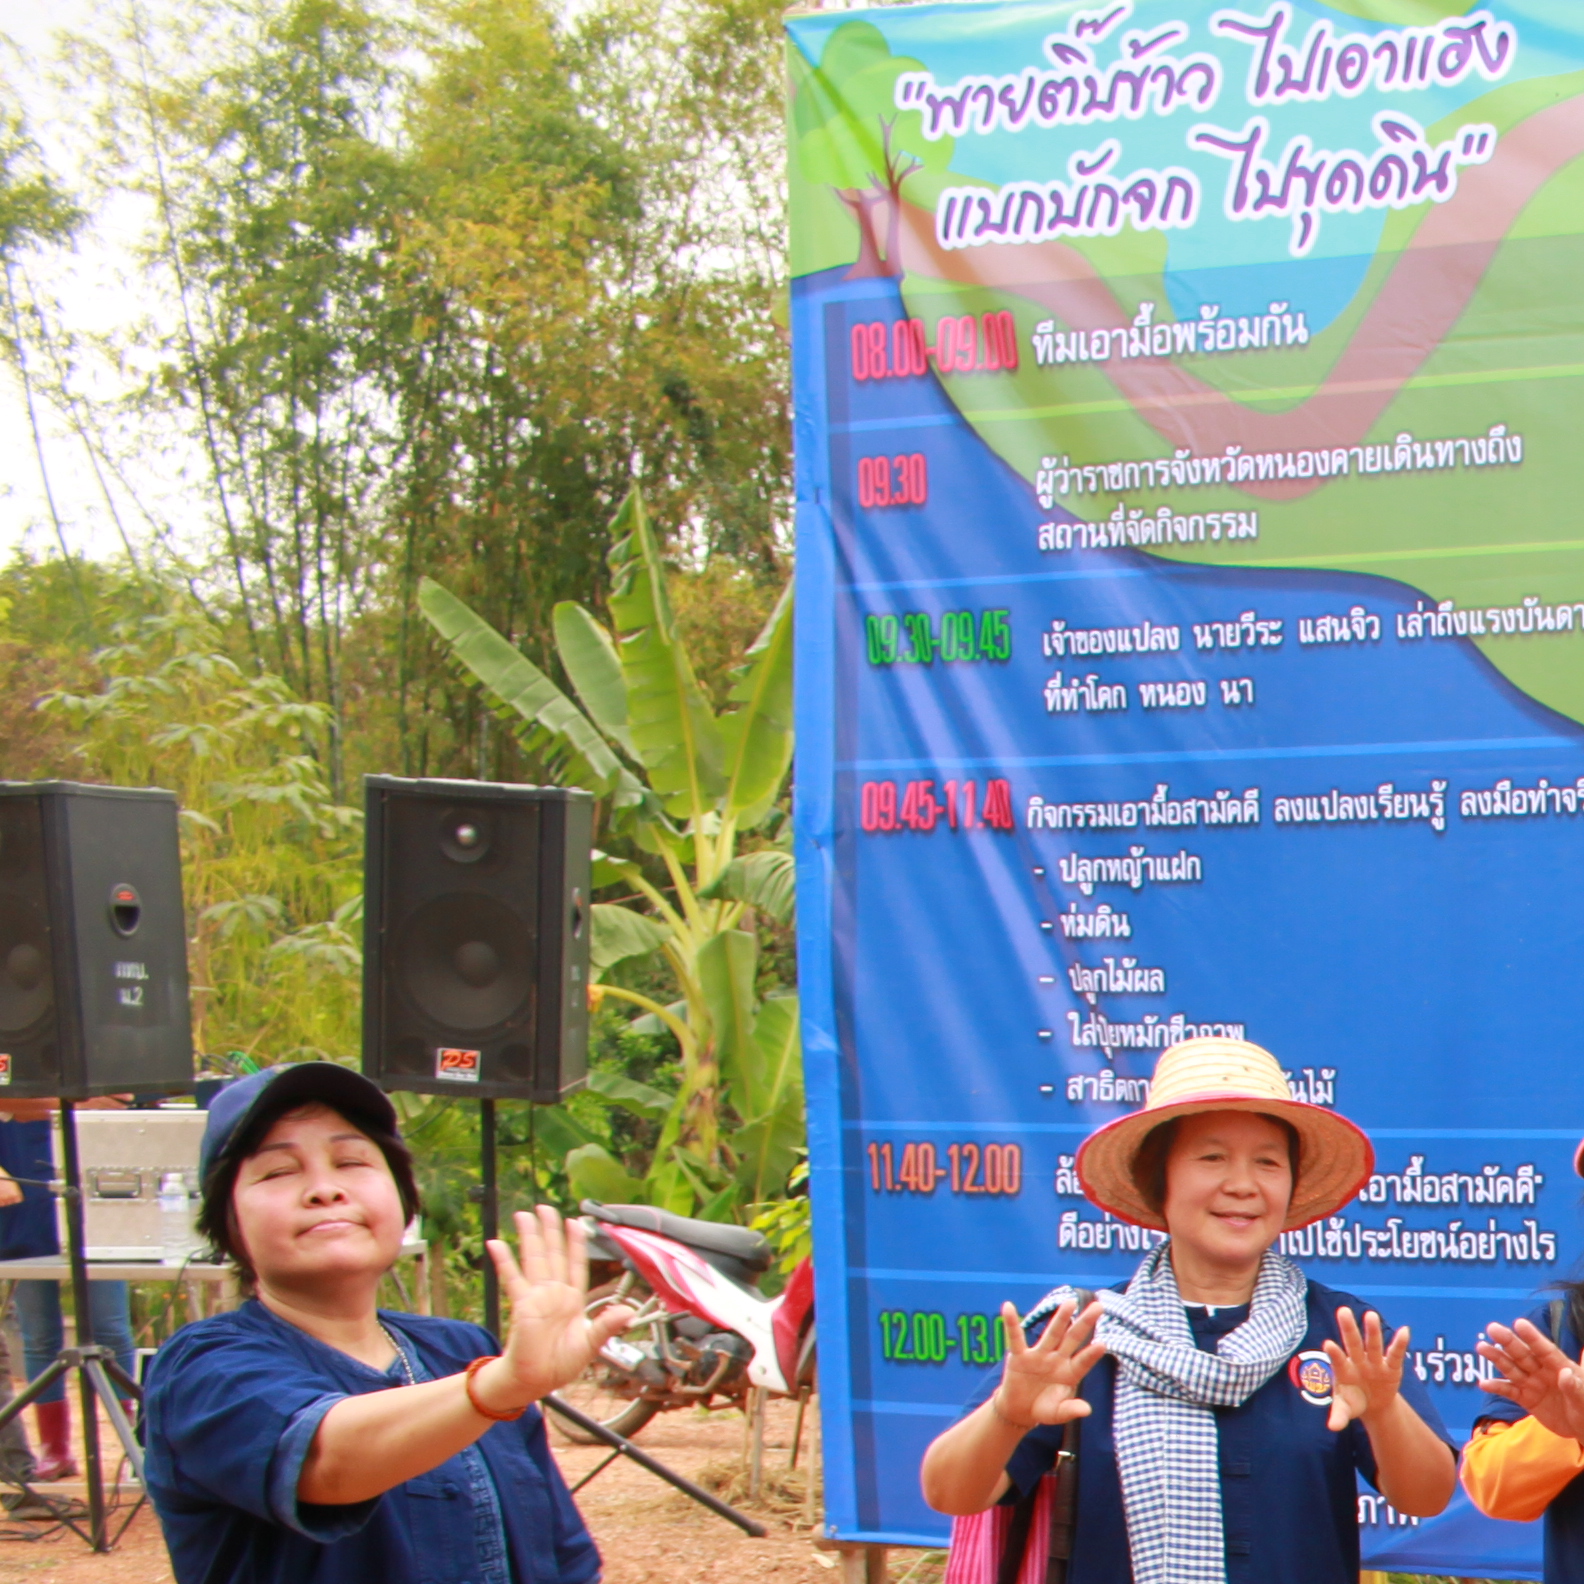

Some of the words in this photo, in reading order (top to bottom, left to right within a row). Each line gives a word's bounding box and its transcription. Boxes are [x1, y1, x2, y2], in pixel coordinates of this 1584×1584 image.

[1218, 10, 1512, 100] ไปเอาแฮง
[850, 311, 1018, 380] 08.00-09.00
[1032, 303, 1309, 366] ทีมเอามื้อพร้อมกัน
[857, 454, 928, 508] 09.30
[1035, 425, 1523, 508] ผู้ว่าราชการจังหวัดหนองคายเดินทางถึง
[1037, 508, 1258, 552] สถานที่จัดกิจกรรม
[1043, 619, 1181, 658] เจ้าของแปลง
[1194, 610, 1284, 652] นายวีระ
[1299, 606, 1381, 645] แสนจิว
[1044, 672, 1127, 713] ที่ทำโคก
[1221, 676, 1254, 704] นา
[861, 779, 1013, 832] 09.45-11.40
[1026, 784, 1260, 829] กิจกรรมเอามื้อสามัคคี
[1274, 780, 1447, 832] ลงแปลงเรียนรู้
[1060, 847, 1201, 895] ปลูกหญ้าแฝก
[1068, 957, 1165, 1004] ปลูกไม้ผล
[867, 1142, 1021, 1193] 11.40-12.00
[880, 1312, 1011, 1364] 12.00-13.0
